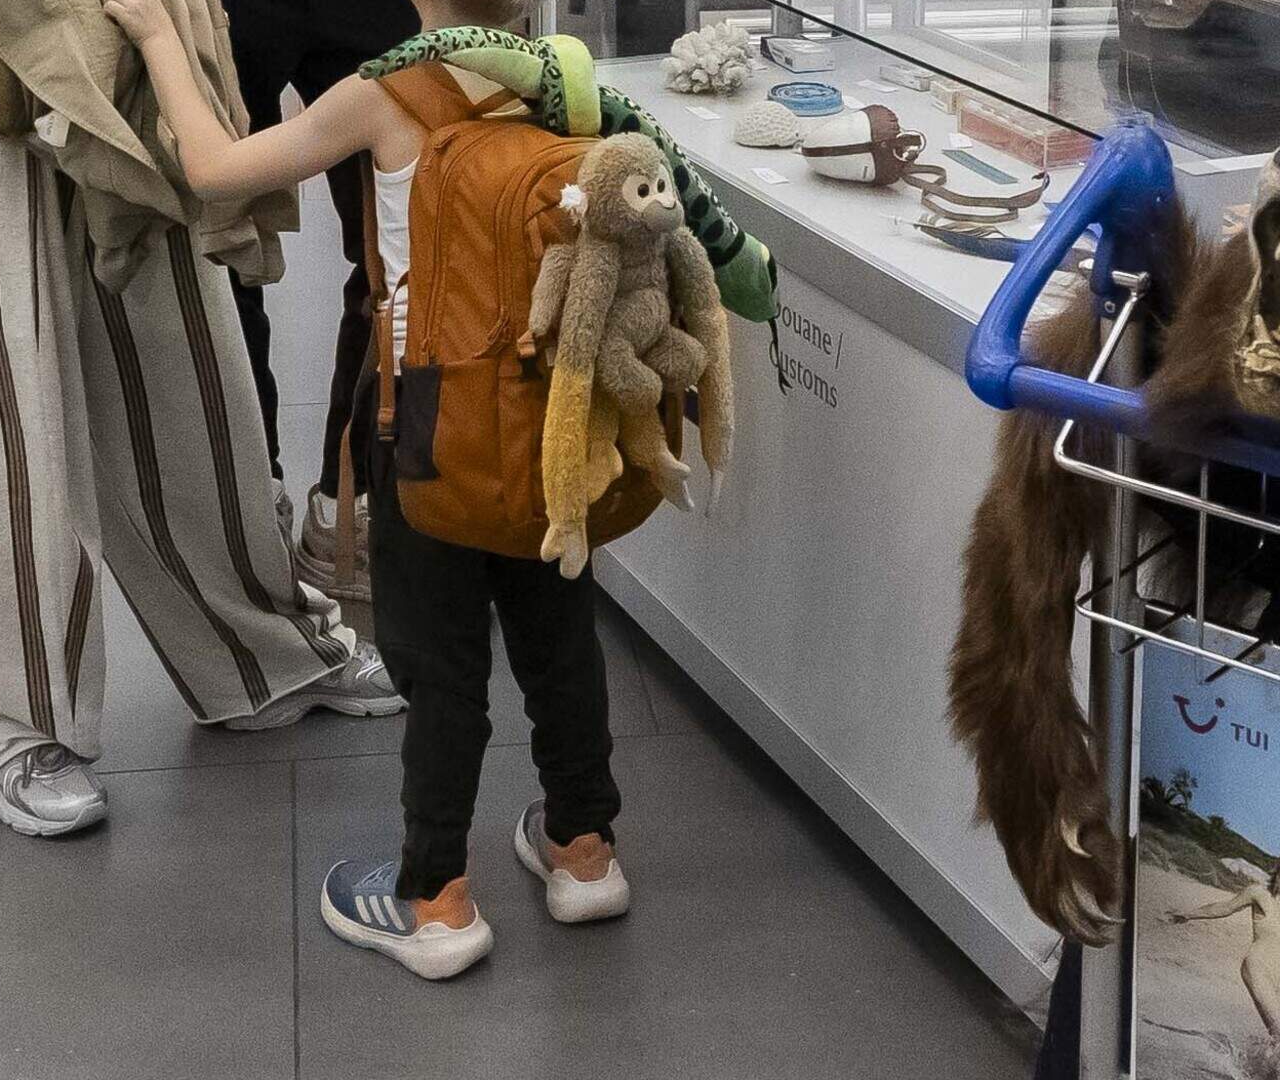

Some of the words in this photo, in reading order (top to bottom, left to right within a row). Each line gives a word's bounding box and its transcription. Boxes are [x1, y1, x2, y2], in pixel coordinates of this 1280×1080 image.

[835, 332, 844, 370] /
[769, 340, 838, 409] Customs
[1230, 722, 1269, 751] TUI
